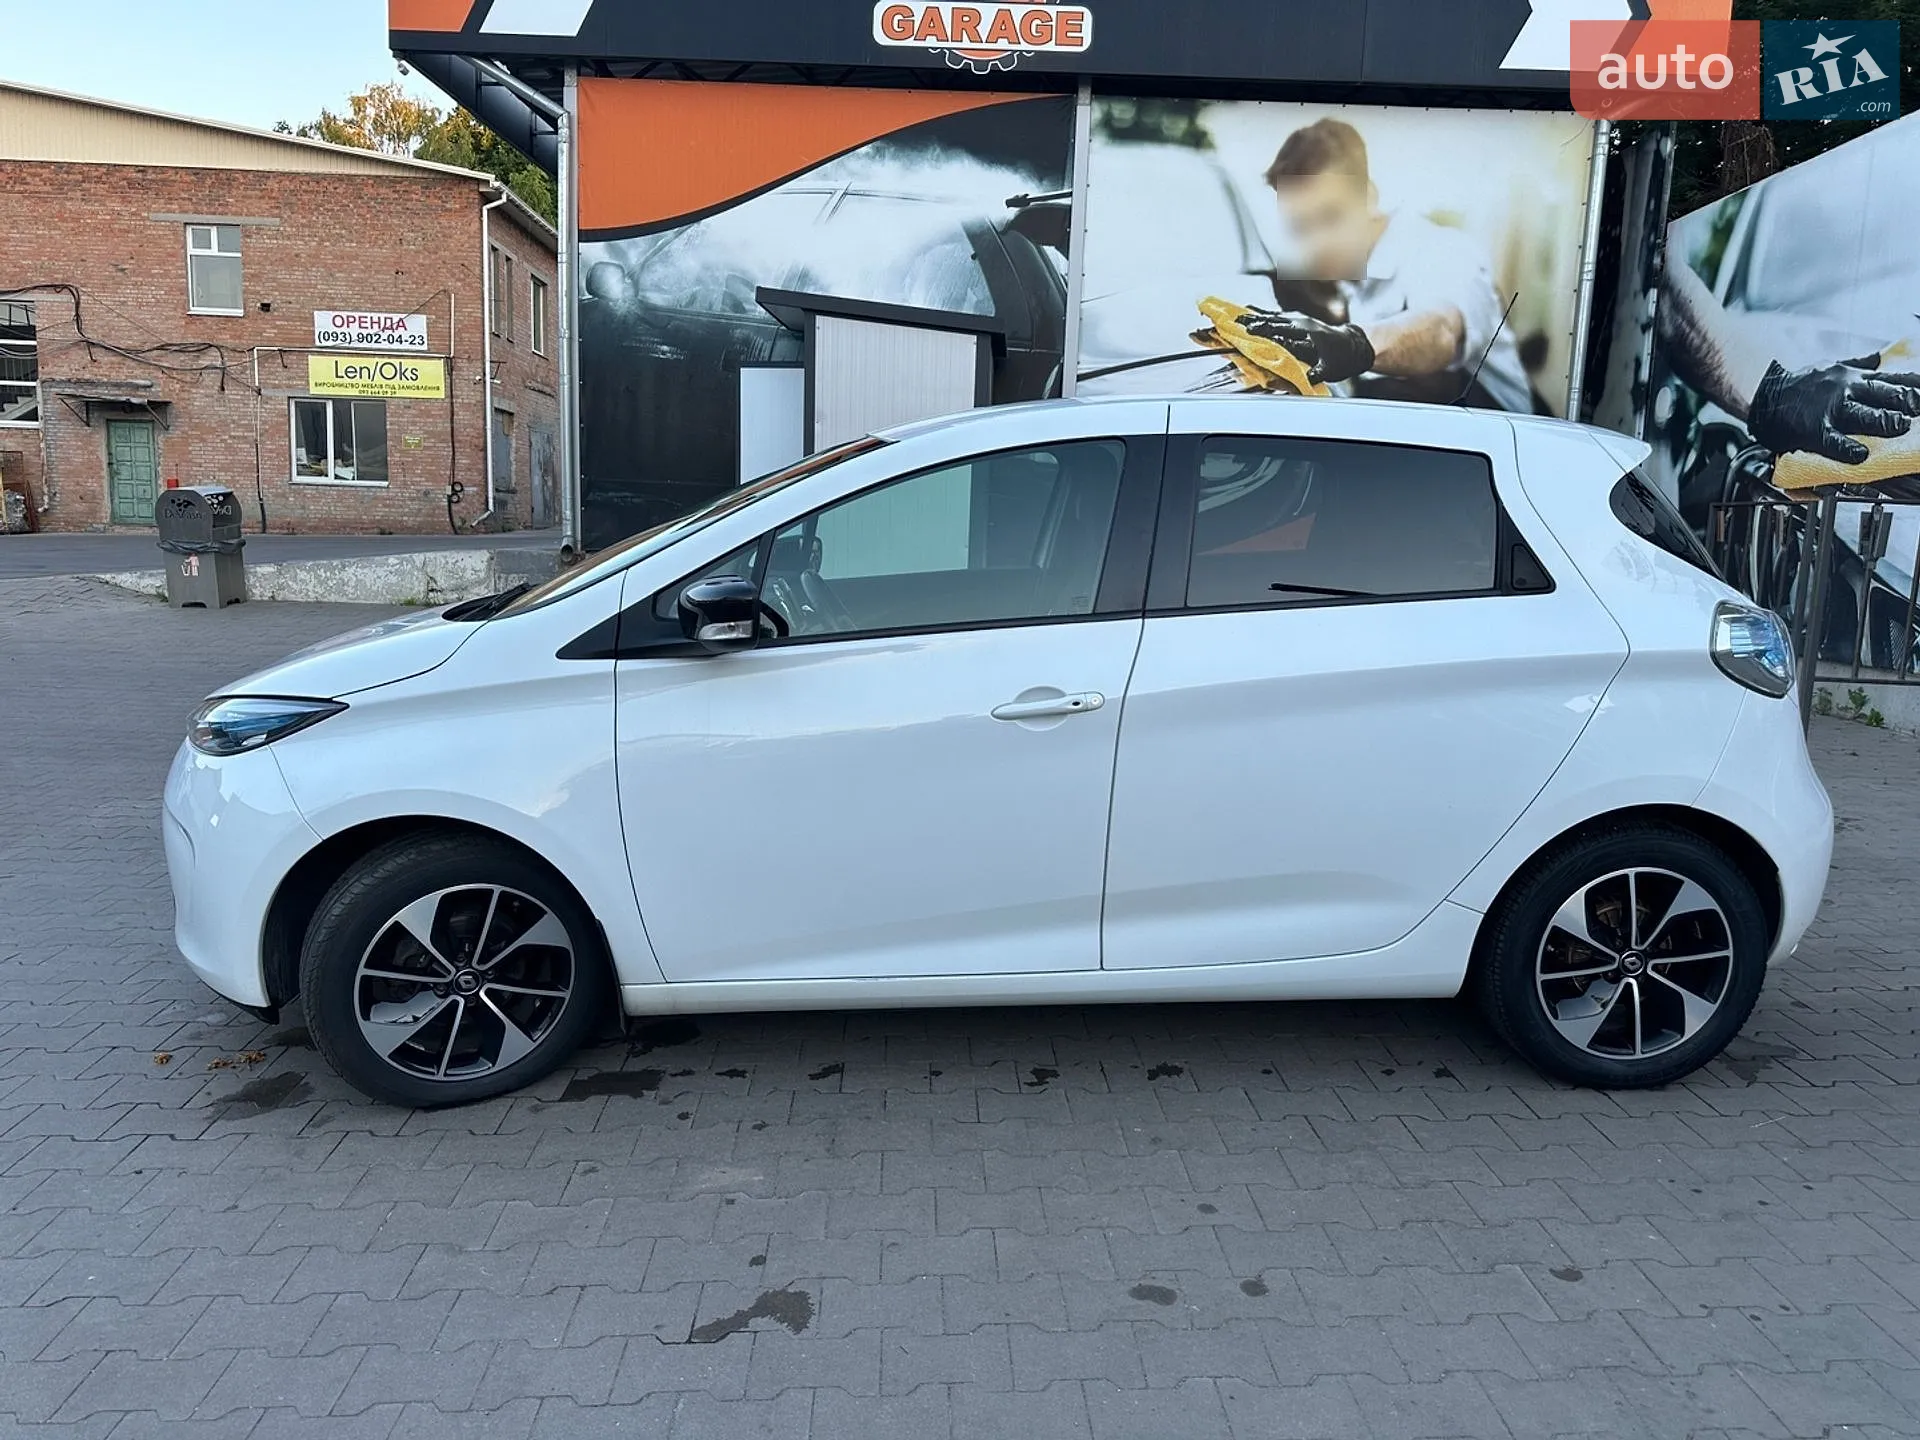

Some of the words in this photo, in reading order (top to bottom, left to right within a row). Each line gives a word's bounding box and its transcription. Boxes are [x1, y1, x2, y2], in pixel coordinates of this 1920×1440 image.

[881, 5, 1084, 46] GARAGE
[332, 314, 408, 333] ОРЕНДА
[318, 331, 352, 345] (093)
[357, 333, 425, 346] 902-04-23
[334, 360, 419, 381] Len/Oks
